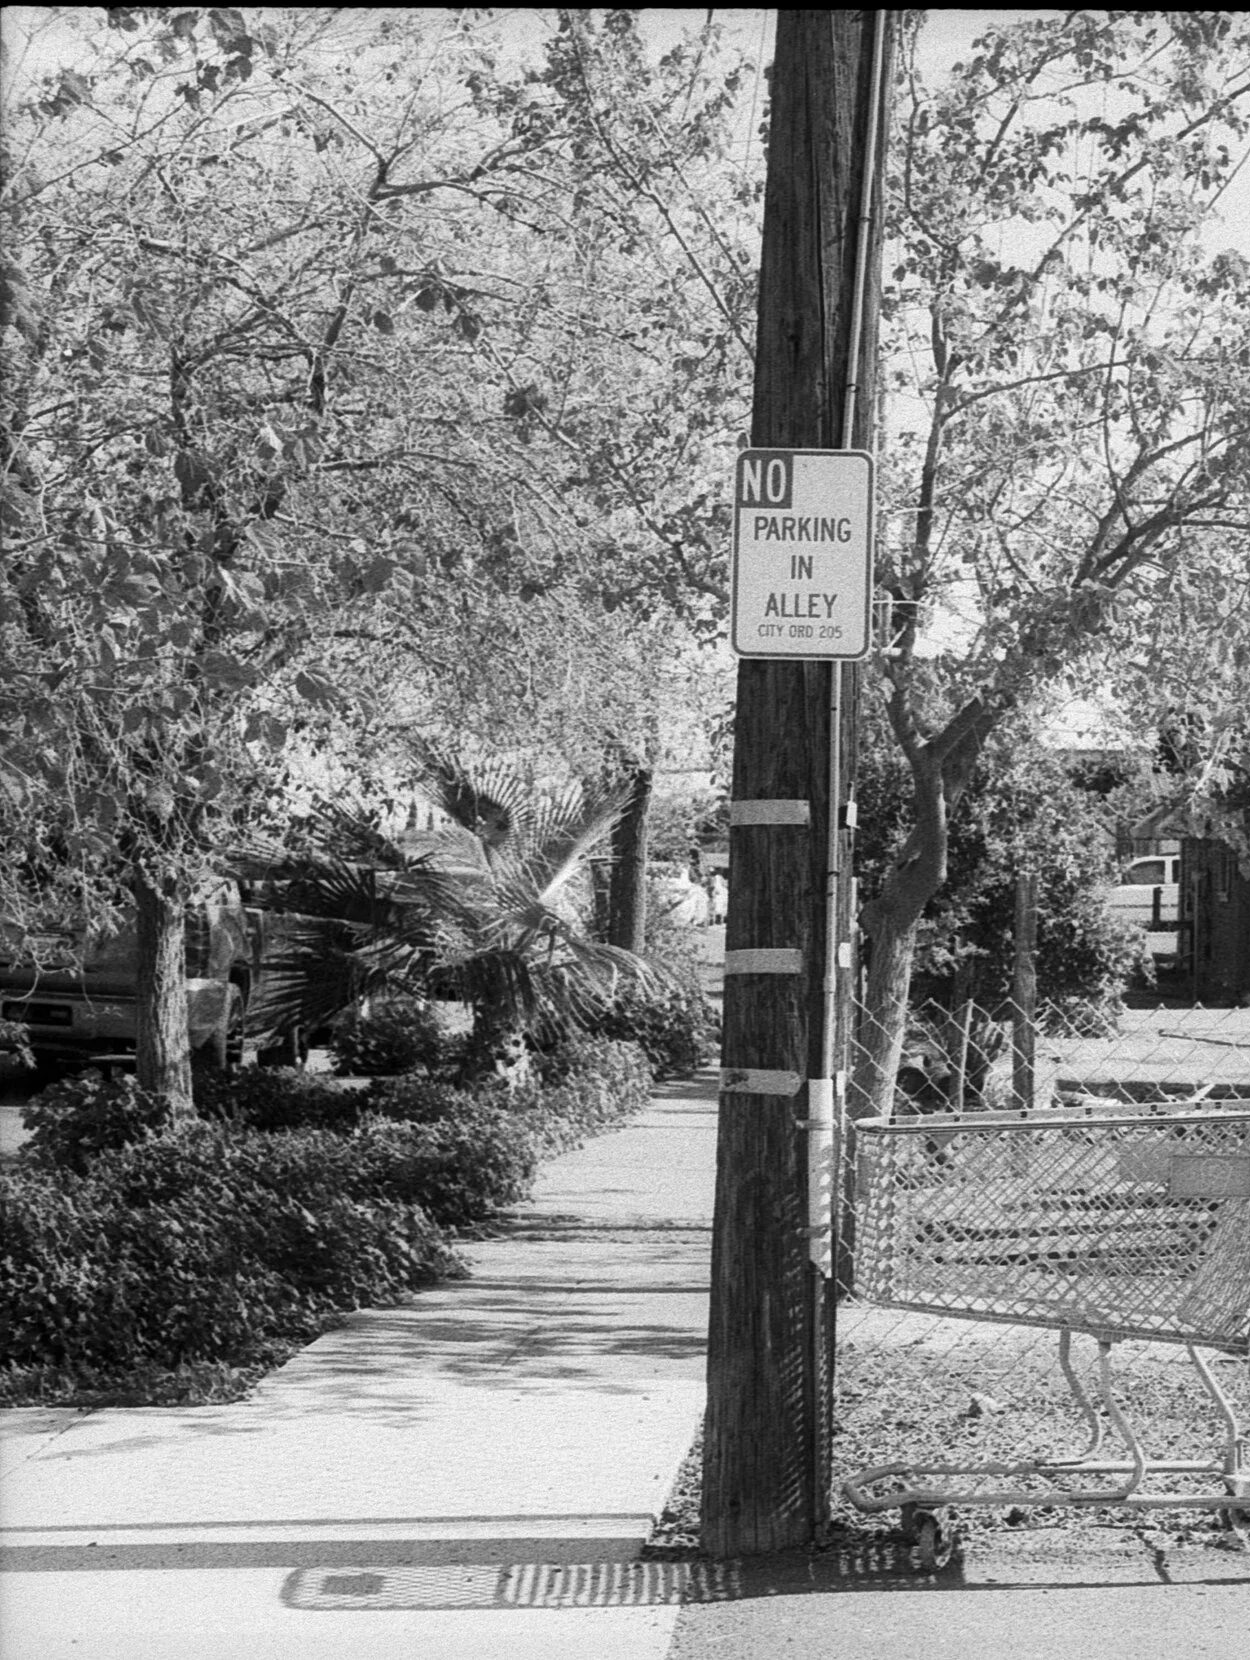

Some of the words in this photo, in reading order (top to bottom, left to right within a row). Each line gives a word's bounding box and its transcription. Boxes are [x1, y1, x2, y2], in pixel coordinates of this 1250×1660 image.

[742, 459, 787, 503] NO
[754, 516, 852, 543] PARKING
[791, 555, 813, 580] IN
[764, 593, 838, 619] ALLEY
[758, 624, 784, 638] CITY
[789, 625, 814, 638] ORD
[819, 625, 843, 639] 205
